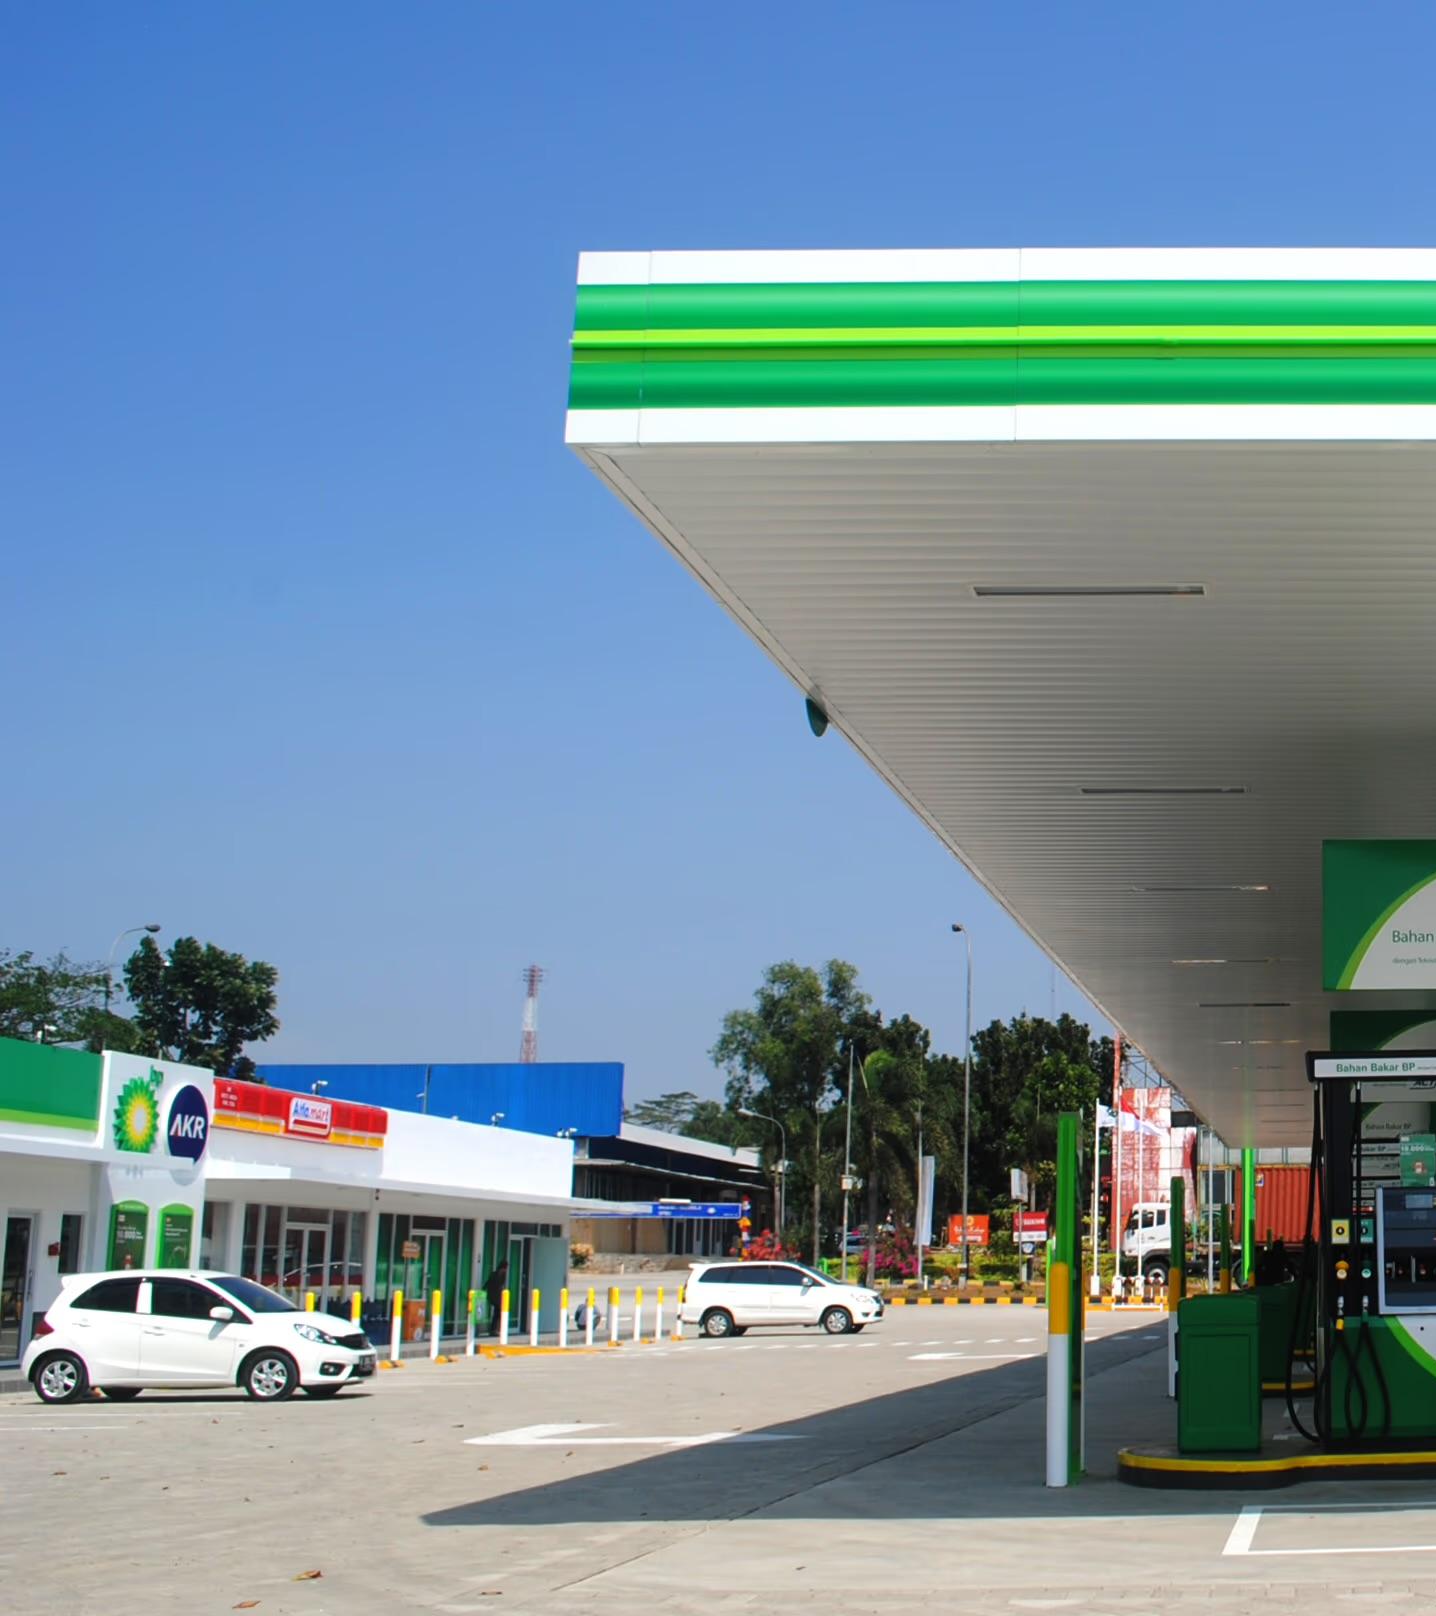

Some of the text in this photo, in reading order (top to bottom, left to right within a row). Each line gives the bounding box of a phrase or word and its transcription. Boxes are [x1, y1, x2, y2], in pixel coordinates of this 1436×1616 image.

[1392, 930, 1434, 943] Bahan
[1336, 1063, 1367, 1073] Bahan
[1370, 1063, 1400, 1072] Bakar
[1401, 1062, 1416, 1072] BP
[169, 1113, 205, 1139] AKR
